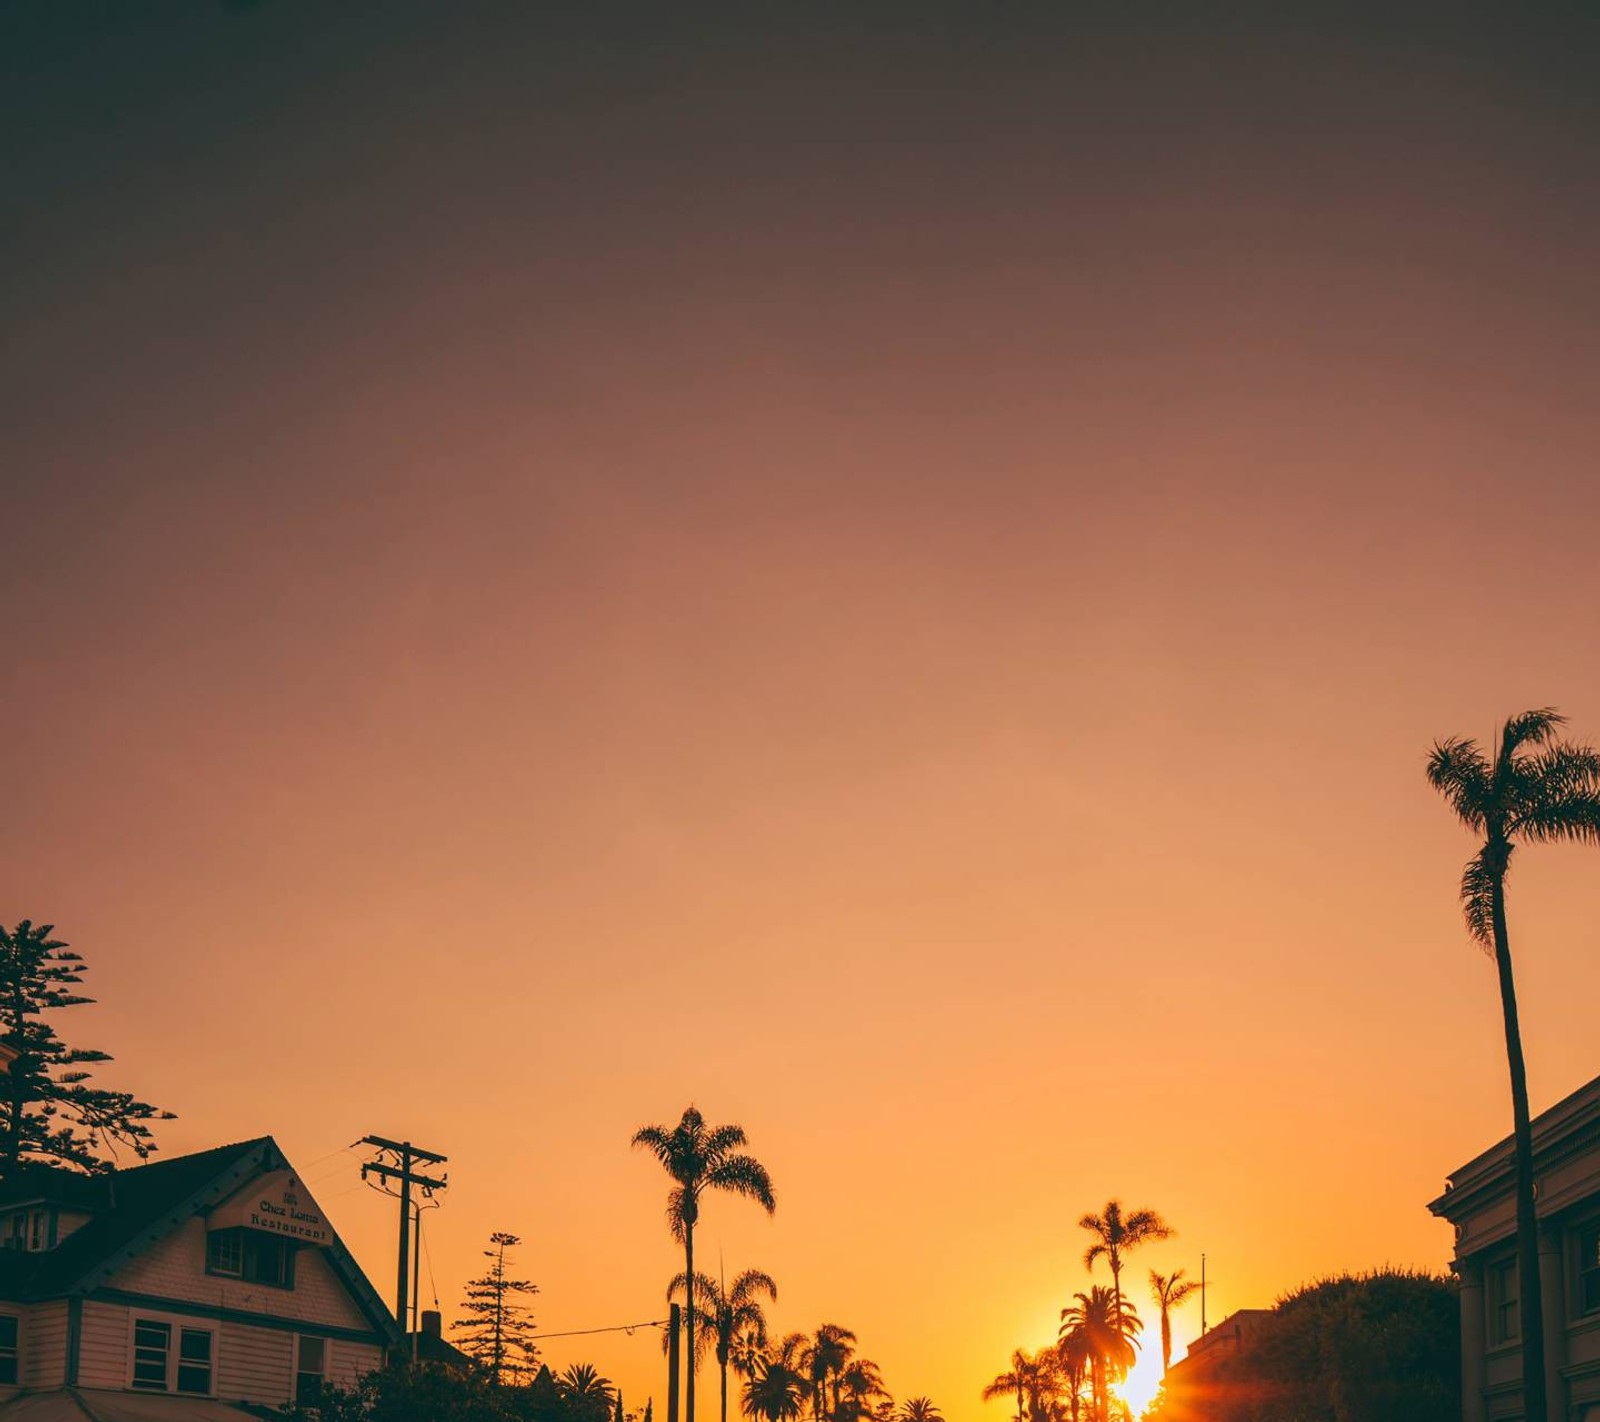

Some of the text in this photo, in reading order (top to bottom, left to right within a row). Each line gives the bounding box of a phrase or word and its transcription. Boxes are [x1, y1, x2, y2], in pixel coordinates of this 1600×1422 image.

[259, 1200, 286, 1216] Chez
[290, 1207, 319, 1224] Loma
[251, 1213, 325, 1240] Restaurant
